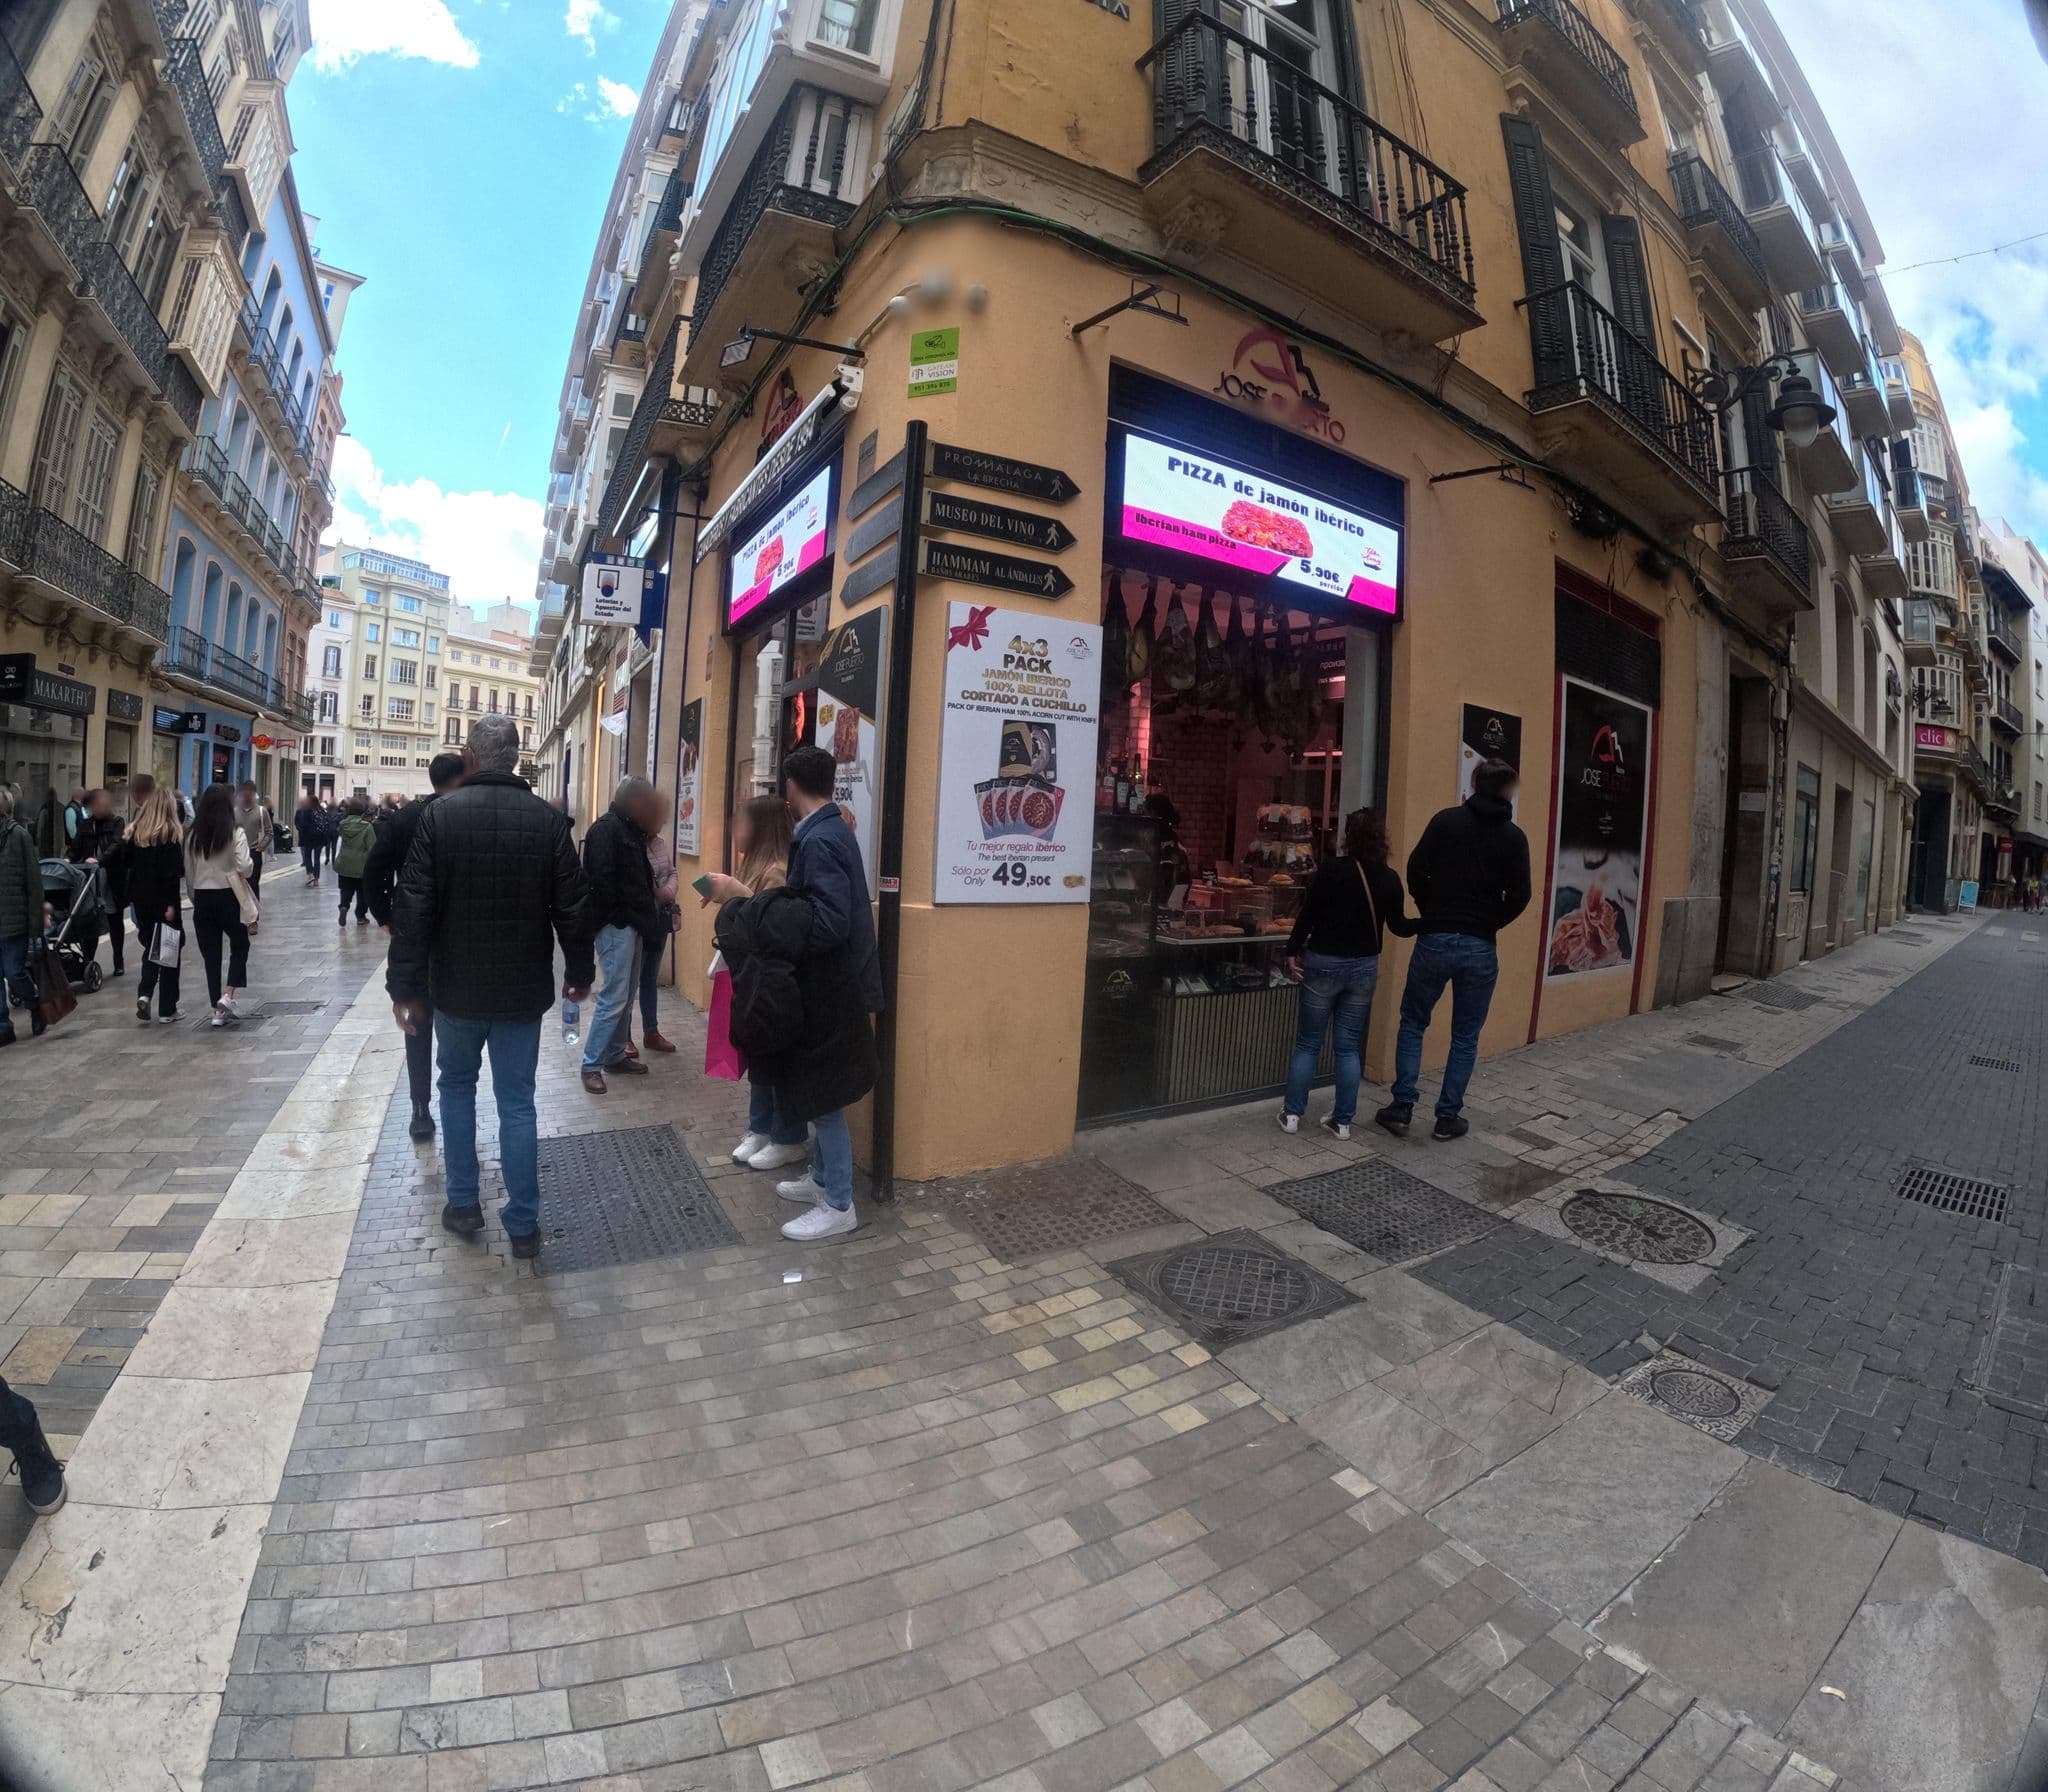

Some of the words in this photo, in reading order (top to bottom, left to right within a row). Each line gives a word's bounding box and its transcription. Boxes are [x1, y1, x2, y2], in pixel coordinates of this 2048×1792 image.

[928, 369, 954, 378] VISION
[1213, 371, 1267, 400] JOSE
[1168, 456, 1226, 489] PIZZA
[1234, 479, 1254, 496] de
[1259, 487, 1309, 517] jamón
[1314, 506, 1365, 537] ibérico
[935, 502, 978, 524] MUSEO
[980, 511, 1003, 530] DEL
[1007, 518, 1035, 536] VINO
[1136, 512, 1180, 534] Iberian
[1182, 525, 1207, 541] ham
[1208, 532, 1237, 550] pizza
[932, 551, 990, 576] HAMMAM
[994, 567, 1005, 578] AL
[1300, 559, 1340, 584] 5.90€
[1008, 635, 1048, 657] 4x3
[1003, 654, 1052, 674] PACK
[982, 668, 1024, 683] JAMÓN
[33, 678, 92, 706] MAKARTHY
[984, 680, 1015, 694] 100%
[1018, 686, 1068, 700] BELLOTA
[961, 690, 1018, 704] CORTADO
[1020, 696, 1030, 706] A
[1032, 698, 1086, 713] CUCHILLO
[947, 702, 964, 710] PACK
[976, 705, 1000, 713] IBERIAN
[1032, 710, 1053, 718] ACORN
[1066, 714, 1080, 722] WITH
[1081, 716, 1097, 724] KNIFE
[1920, 728, 1942, 744] clic
[1580, 767, 1602, 787] JOSE
[967, 840, 978, 850] Tu
[980, 842, 1006, 853] mejor
[1006, 843, 1034, 853] regalo
[1035, 842, 1066, 852] ibérico
[978, 853, 991, 861] The
[1008, 854, 1030, 862] iberian
[952, 866, 972, 876] Sólo
[974, 868, 988, 877] por
[992, 862, 1052, 887] 49,50€
[964, 876, 986, 886] Only
